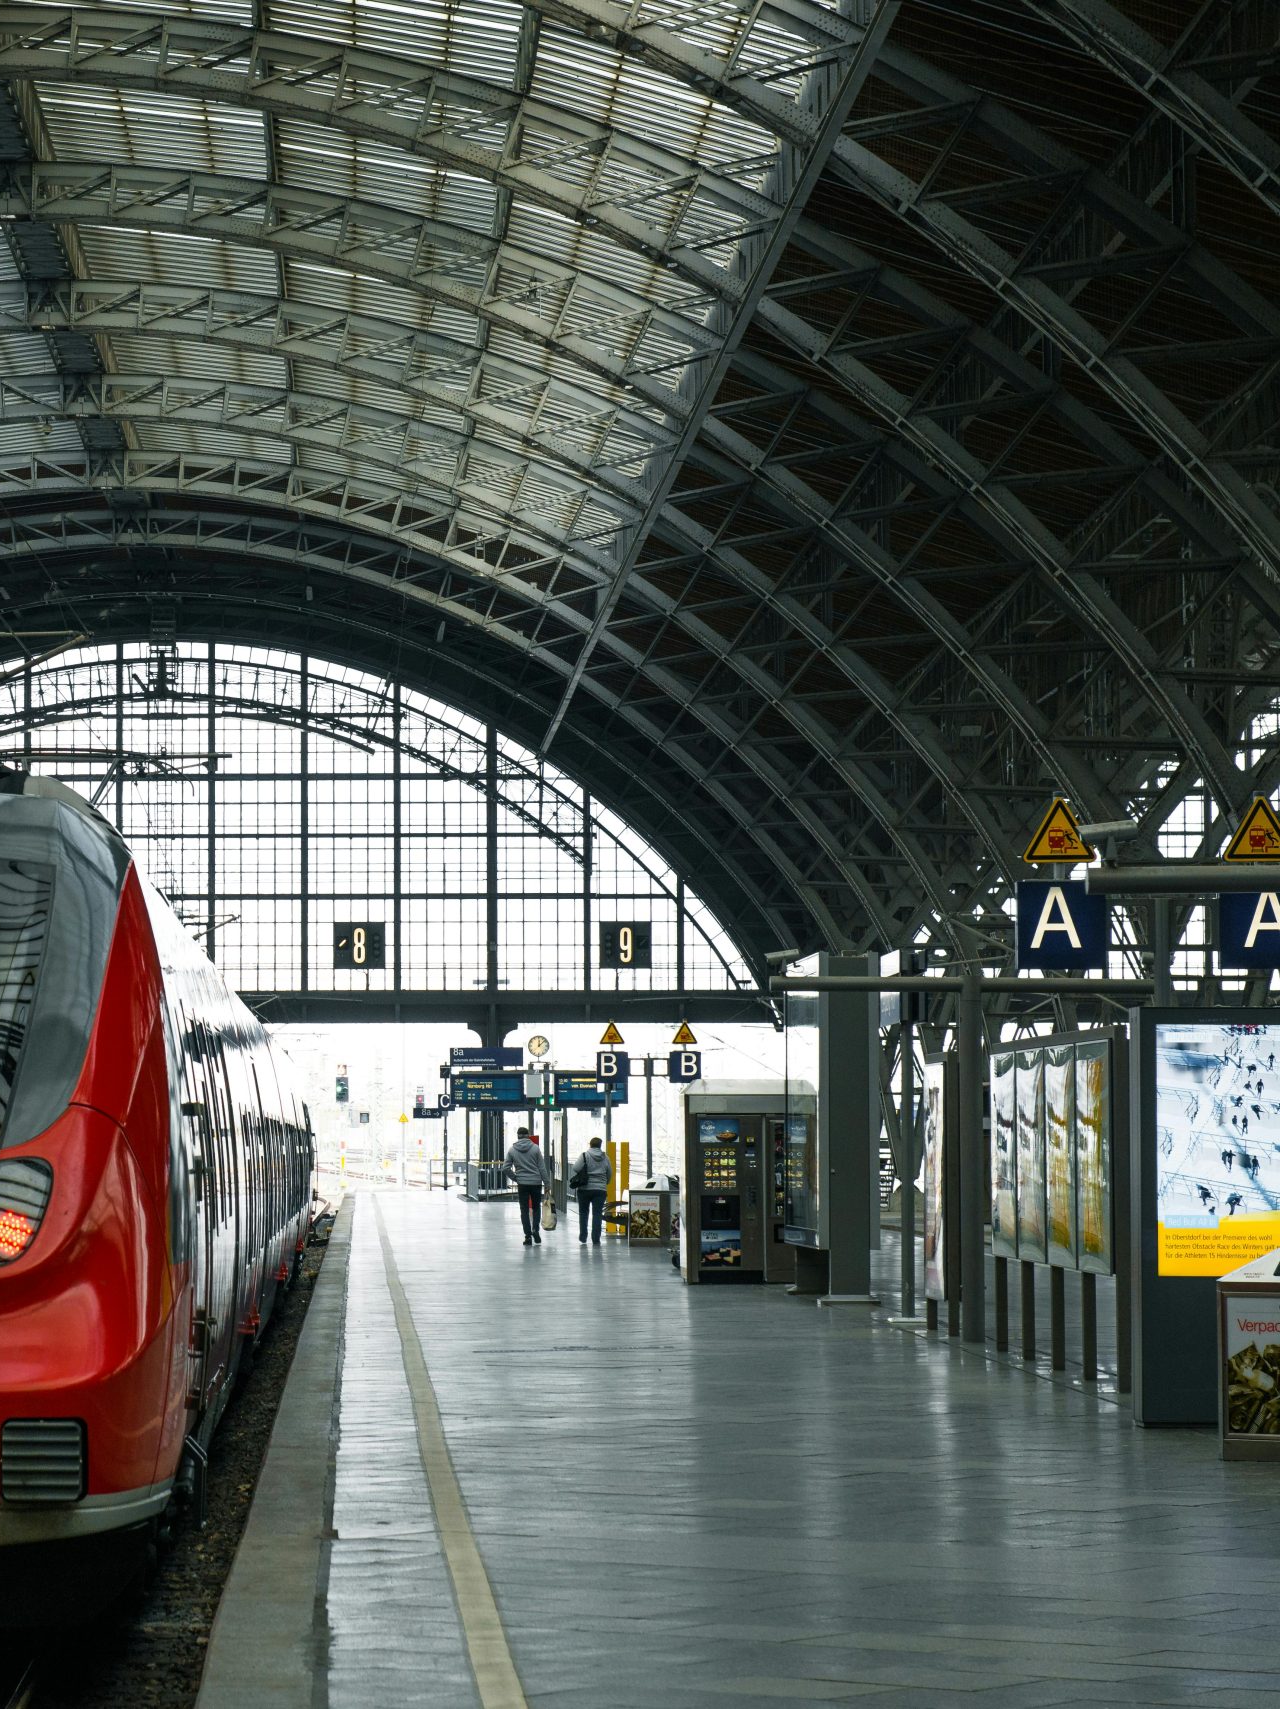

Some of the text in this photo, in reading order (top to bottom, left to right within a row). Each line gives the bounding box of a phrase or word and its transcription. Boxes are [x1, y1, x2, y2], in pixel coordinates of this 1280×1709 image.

[1030, 886, 1082, 949] A
[1243, 892, 1280, 948] A
[353, 928, 366, 964] 8
[619, 927, 632, 963] 9
[453, 1047, 464, 1056] 8a
[600, 1053, 618, 1077] B
[681, 1053, 698, 1077] B
[440, 1094, 450, 1108] C
